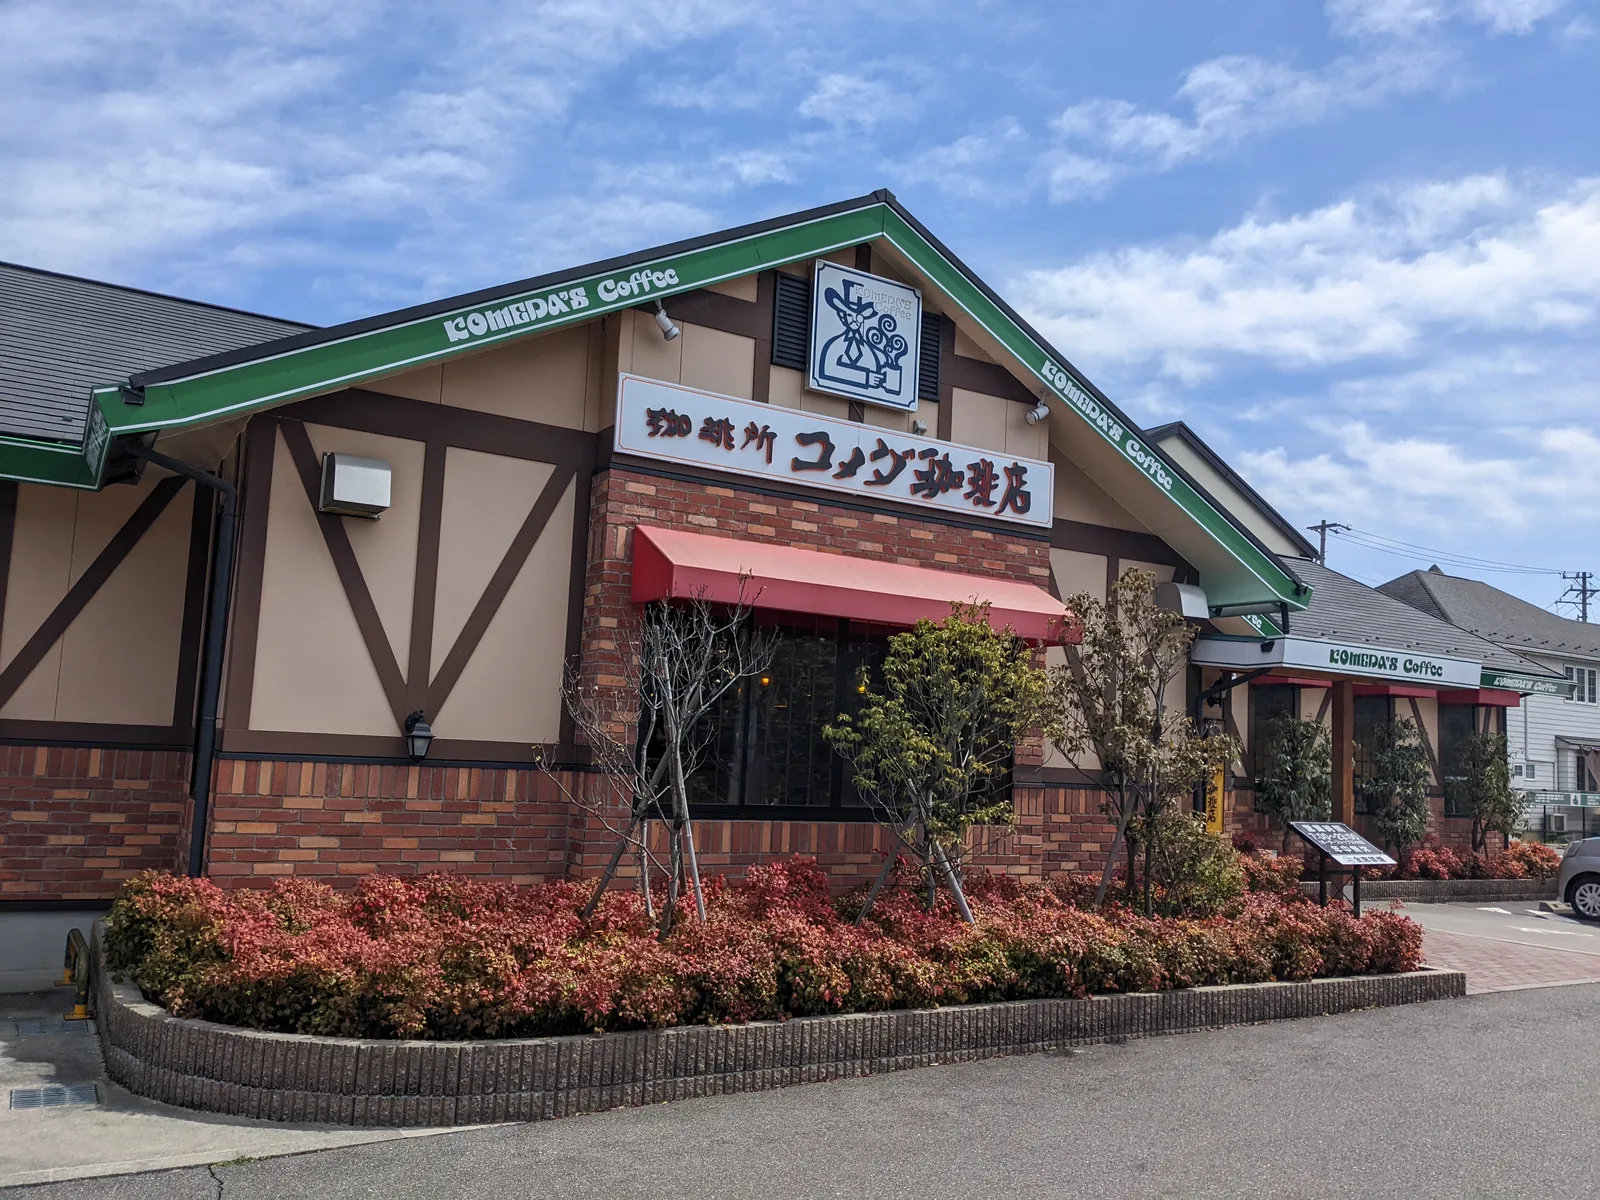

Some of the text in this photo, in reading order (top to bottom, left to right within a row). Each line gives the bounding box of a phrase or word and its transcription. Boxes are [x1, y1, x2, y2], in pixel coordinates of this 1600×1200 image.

[443, 268, 680, 342] KOMEDA'S Coffee
[856, 286, 912, 310] KOMEDA'S
[875, 301, 912, 320] Coffee
[1041, 359, 1173, 490] KOMEDA'S Coffee
[646, 407, 1032, 515] 珈琲所 コメダ珈琲店
[1329, 649, 1443, 677] KOMEDA'S Coffee
[1493, 677, 1558, 692] KOMEDA'S Coffee
